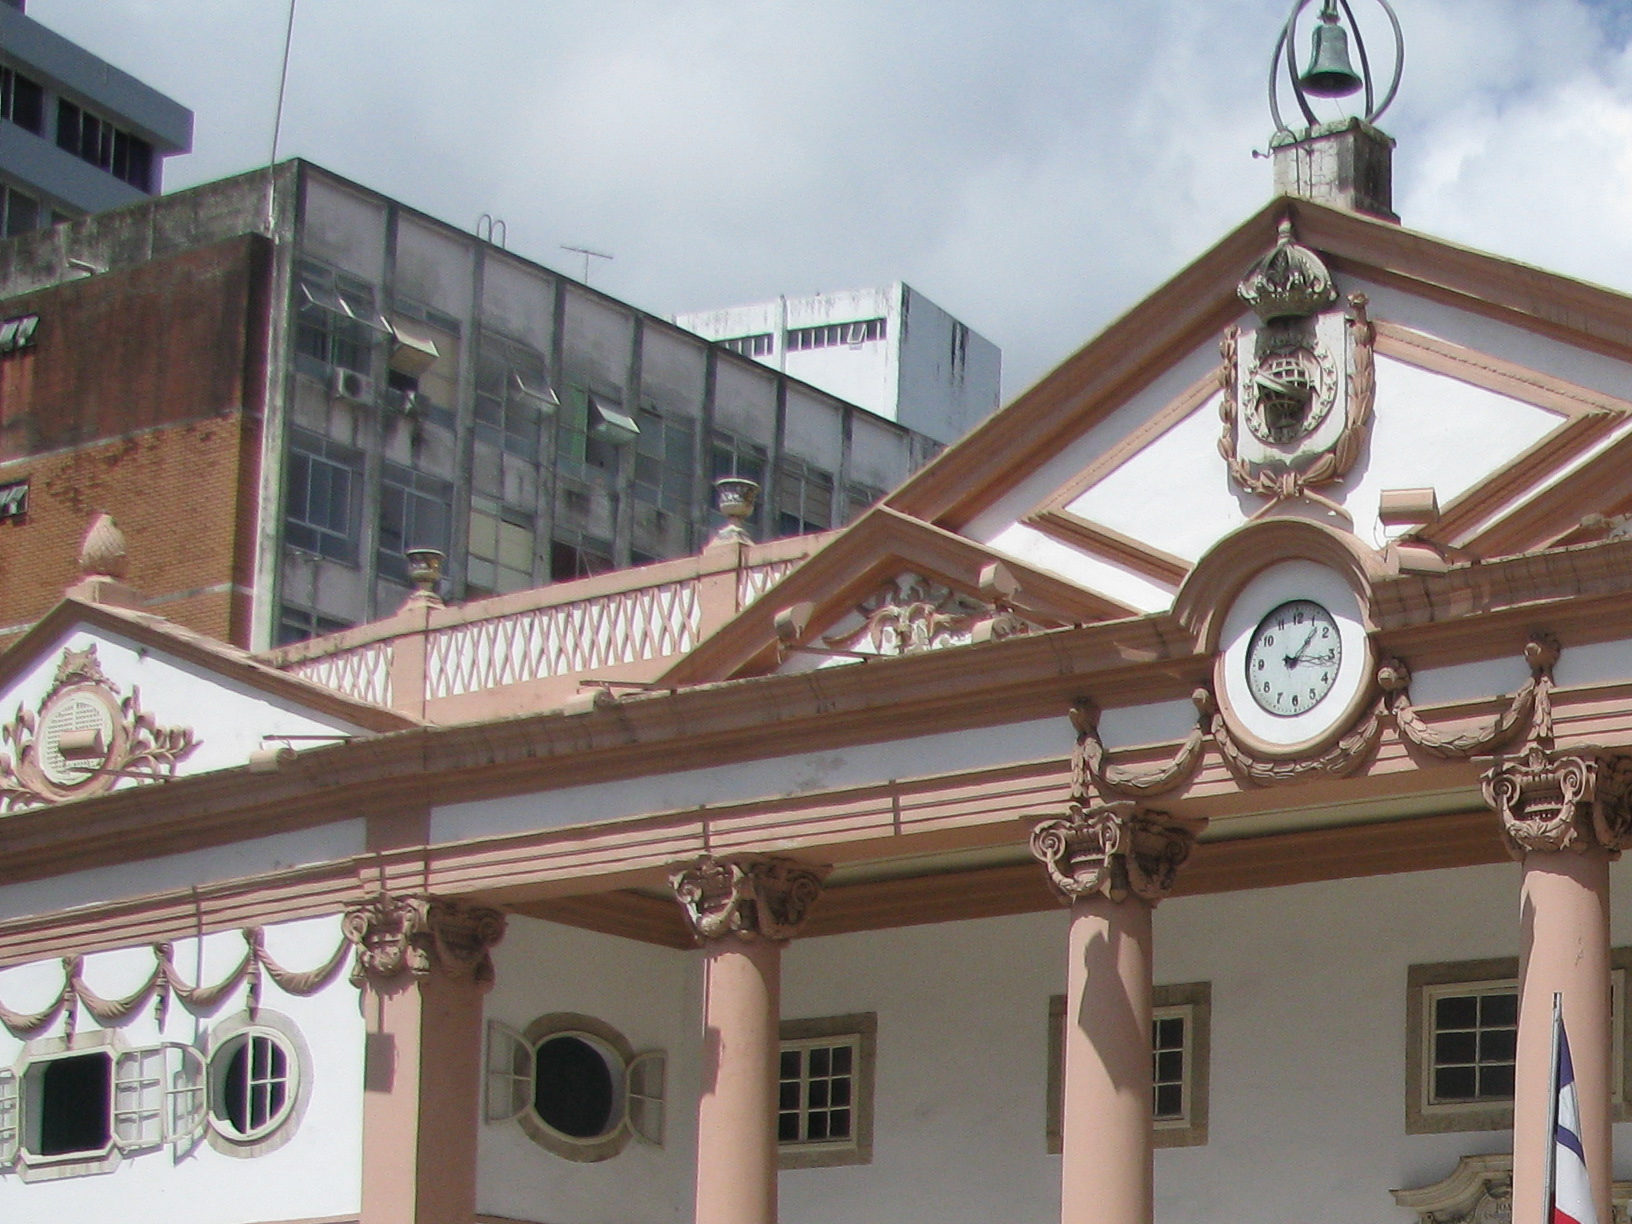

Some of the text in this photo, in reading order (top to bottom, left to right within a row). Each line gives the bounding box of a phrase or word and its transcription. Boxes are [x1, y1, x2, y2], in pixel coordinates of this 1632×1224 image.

[1293, 612, 1304, 625] 12
[1278, 620, 1285, 631] 11
[1322, 627, 1329, 638] 2
[1263, 636, 1273, 647] 10
[1328, 648, 1335, 660] 3
[1258, 659, 1264, 670] 9
[1320, 672, 1328, 684] 4
[1263, 681, 1270, 693] 8
[1276, 692, 1283, 704] 7
[1309, 688, 1316, 700] 5
[1292, 695, 1298, 707] 6
